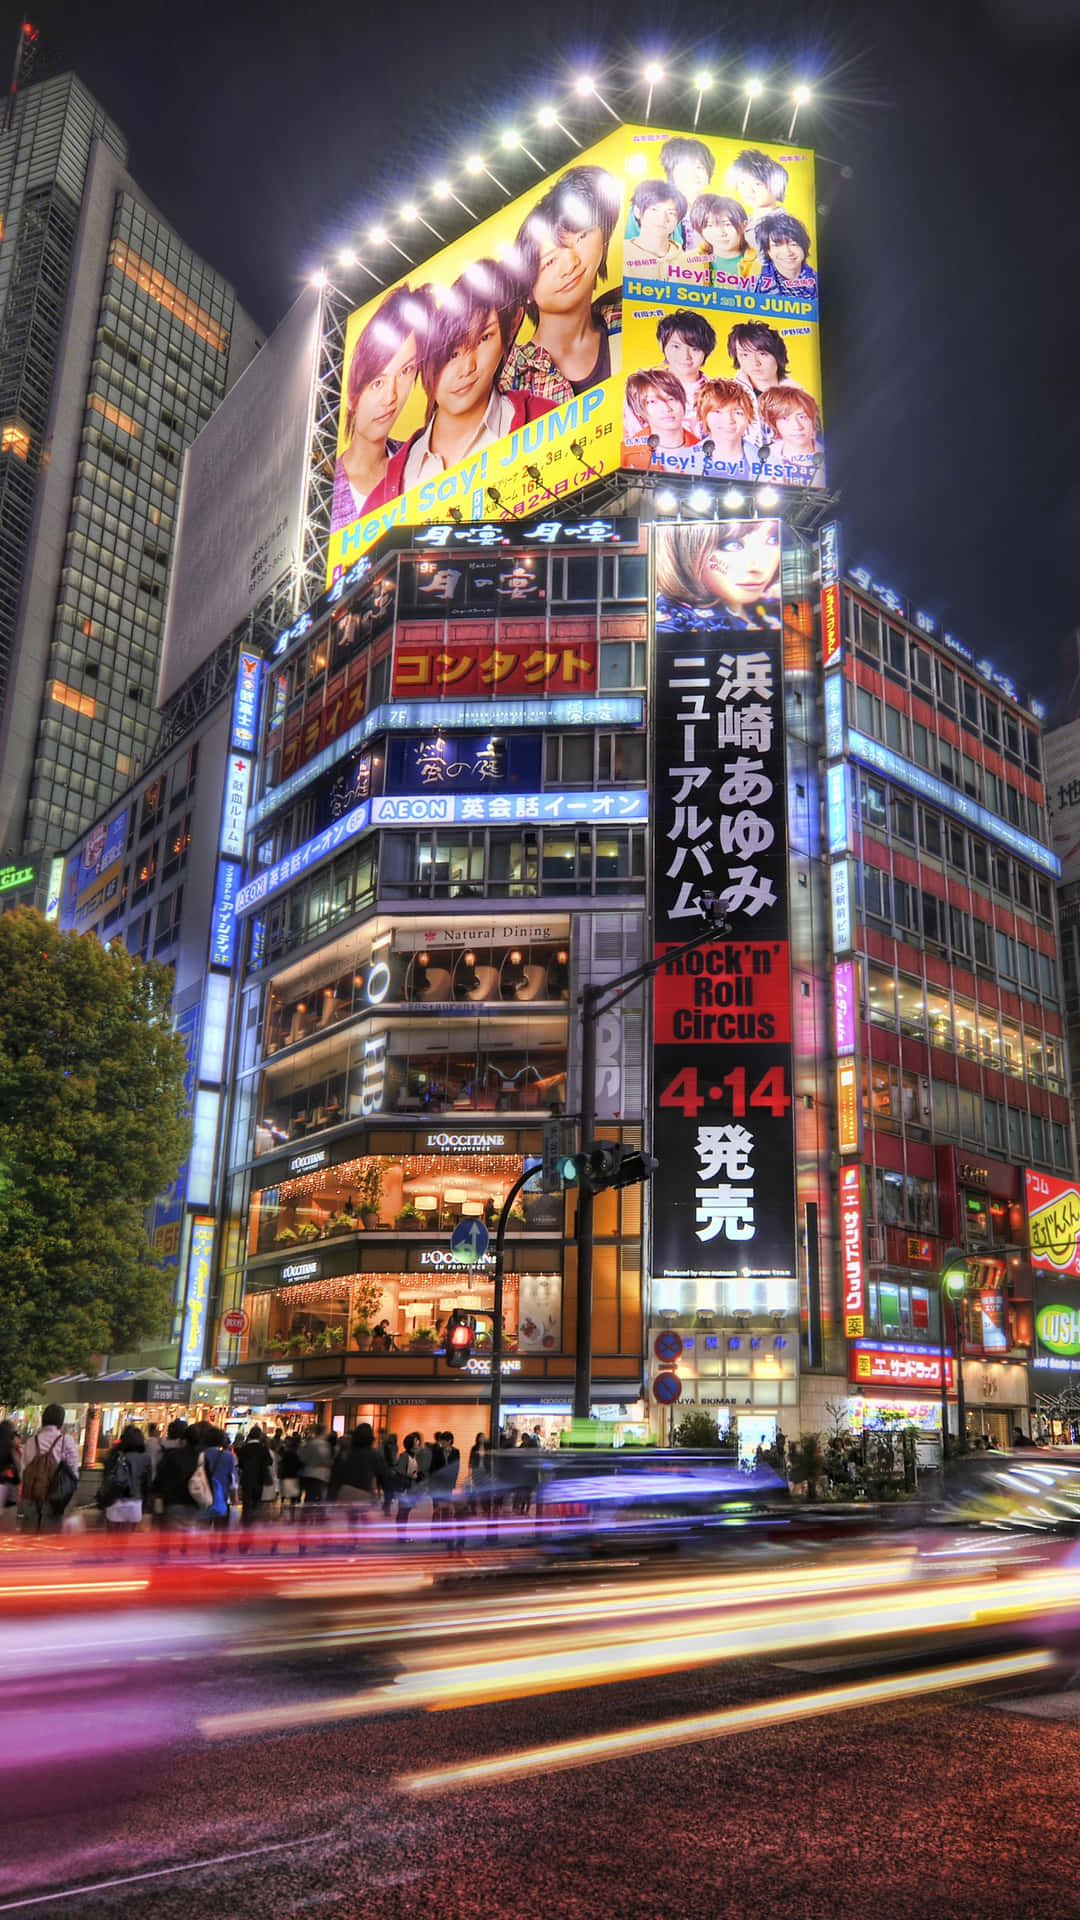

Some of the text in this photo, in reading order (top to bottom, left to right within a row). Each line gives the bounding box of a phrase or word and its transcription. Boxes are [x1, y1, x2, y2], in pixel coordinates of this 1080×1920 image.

[667, 264, 773, 289] Hey! Say! 7
[627, 281, 671, 298] Hey!
[677, 287, 718, 304] Say!
[760, 298, 813, 315] JUMP
[340, 387, 606, 556] Hey! Say! JUMP
[651, 451, 794, 478] Hey! Say! BEST
[395, 650, 593, 684] コンタクト
[390, 711, 407, 722] 7F
[666, 655, 714, 919] ニューアルバム
[716, 651, 778, 918] 浜崎あゆみ
[381, 795, 642, 820] AEON 英会話イーオン
[238, 873, 267, 911] AEON
[443, 926, 551, 941] Natural Dining
[665, 944, 781, 976] Rock'n'
[694, 977, 754, 1008] Roll
[673, 1009, 776, 1041] Circus
[427, 1134, 505, 1147] L'OCCITANE
[694, 1124, 756, 1242] 発売
[683, 1336, 787, 1350] 谷駅前ビル
[889, 1359, 940, 1379] サンドラッグ
